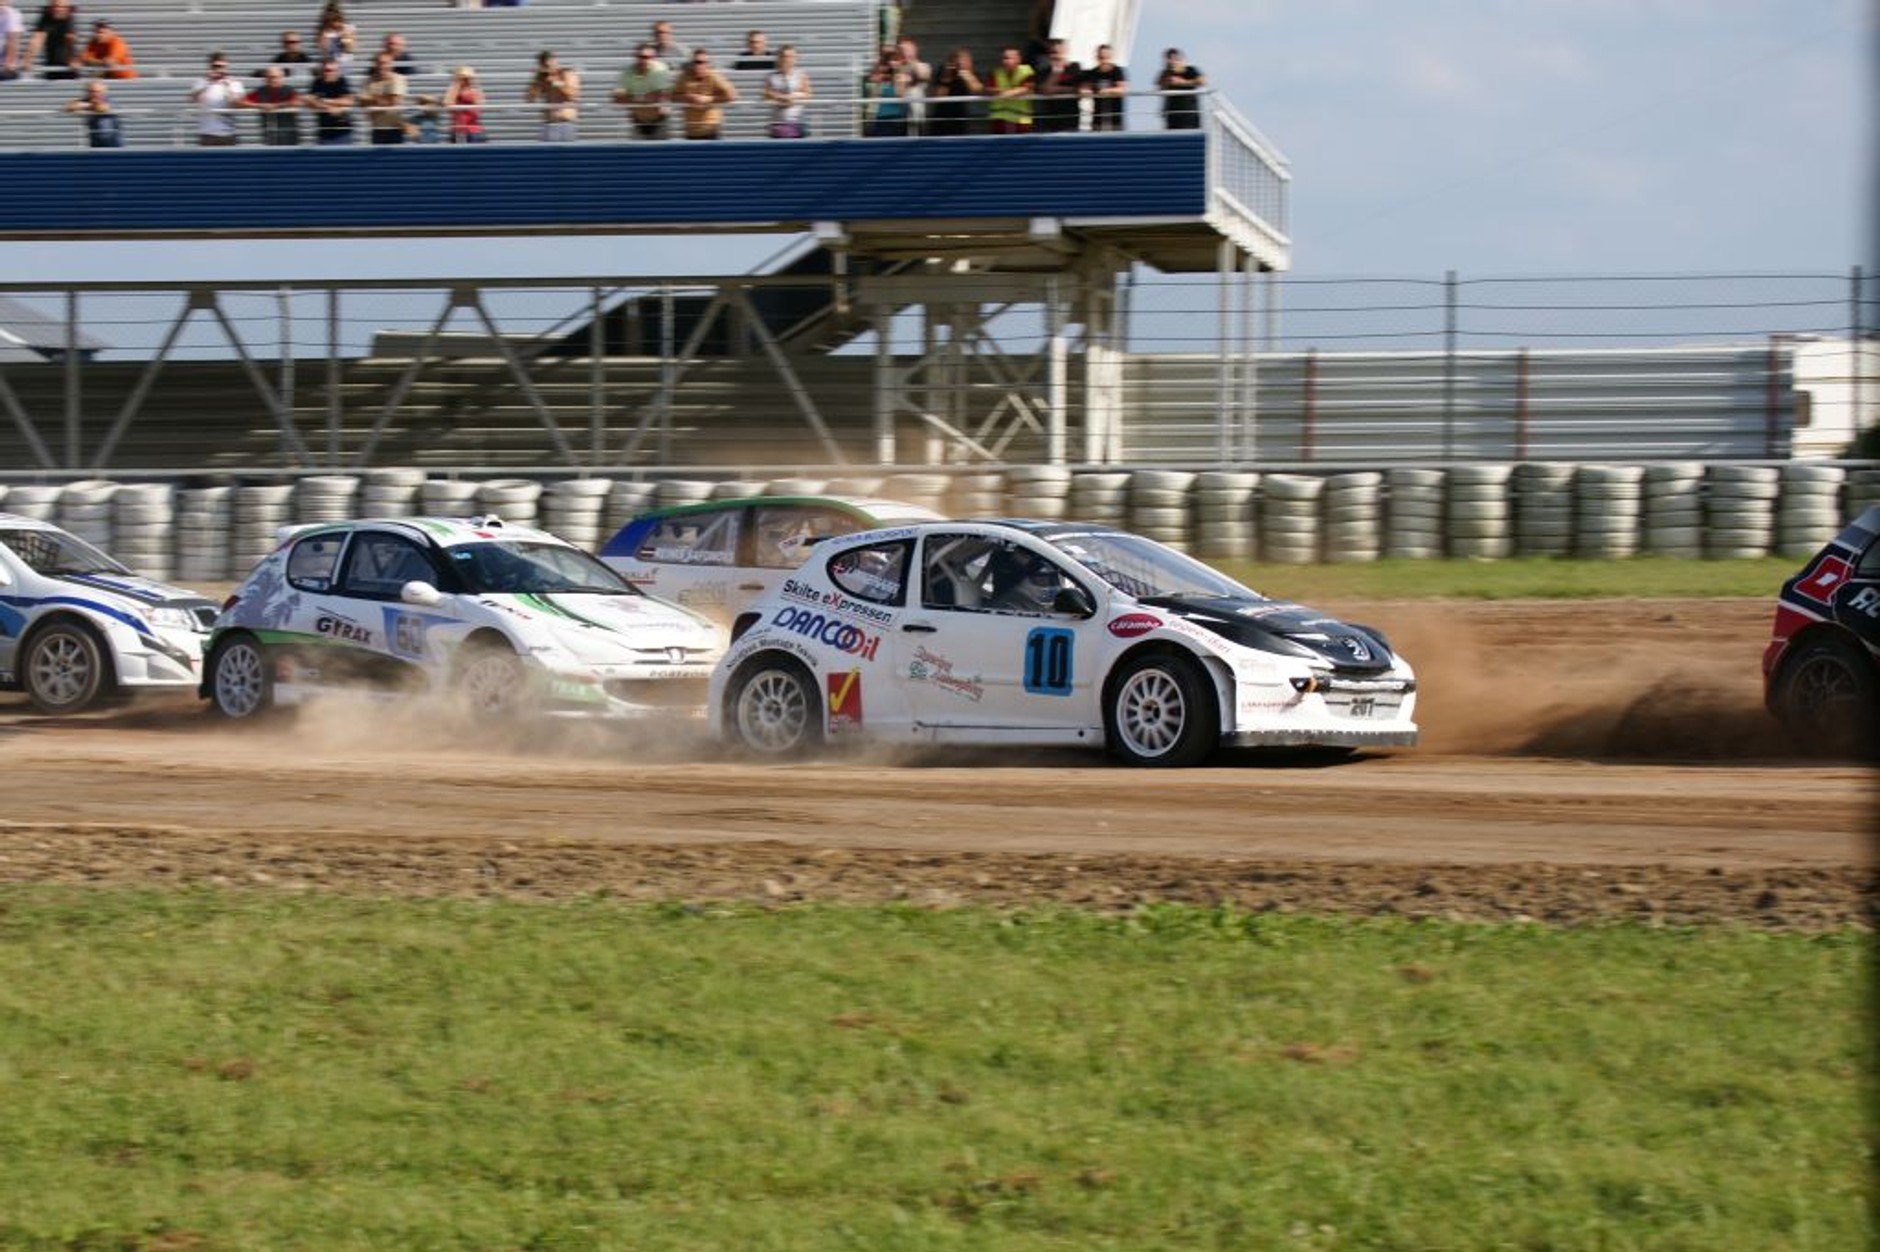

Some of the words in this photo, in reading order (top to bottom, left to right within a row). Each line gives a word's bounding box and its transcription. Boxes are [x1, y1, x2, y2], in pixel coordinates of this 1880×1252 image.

[783, 579, 820, 602] Skilte
[822, 592, 892, 623] eXpressen
[1029, 632, 1070, 689] 10
